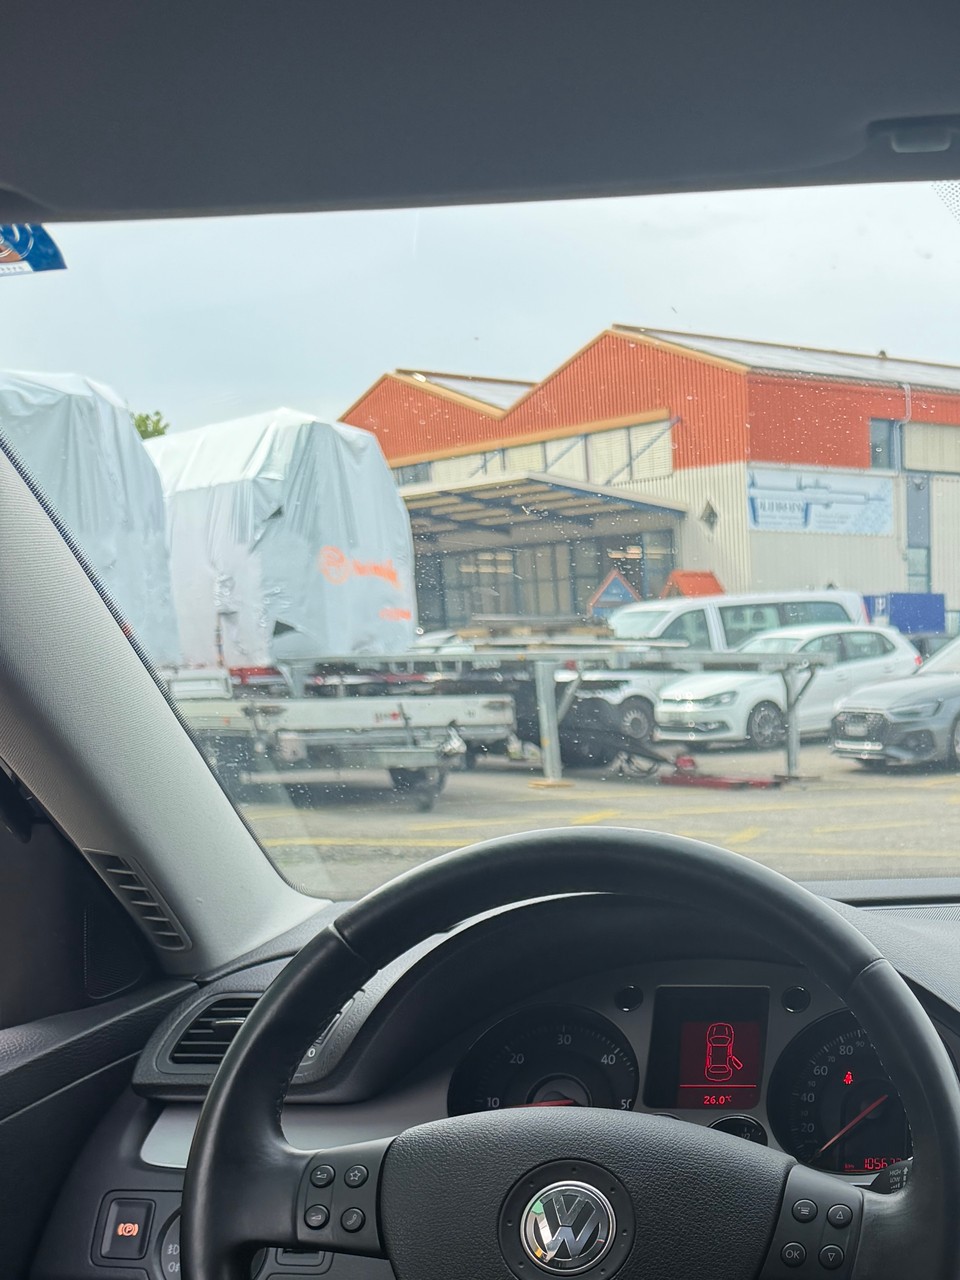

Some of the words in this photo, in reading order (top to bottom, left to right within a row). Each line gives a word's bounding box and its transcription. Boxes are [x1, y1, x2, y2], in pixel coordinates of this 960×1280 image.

[557, 1034, 572, 1045] 30
[839, 1045, 853, 1056] 80
[509, 1053, 525, 1064] 20
[600, 1054, 616, 1065] 40
[813, 1066, 828, 1076] 60
[486, 1097, 500, 1108] 10
[800, 1092, 815, 1103] 40
[800, 1122, 815, 1133] 20
[785, 1249, 800, 1260] OK
